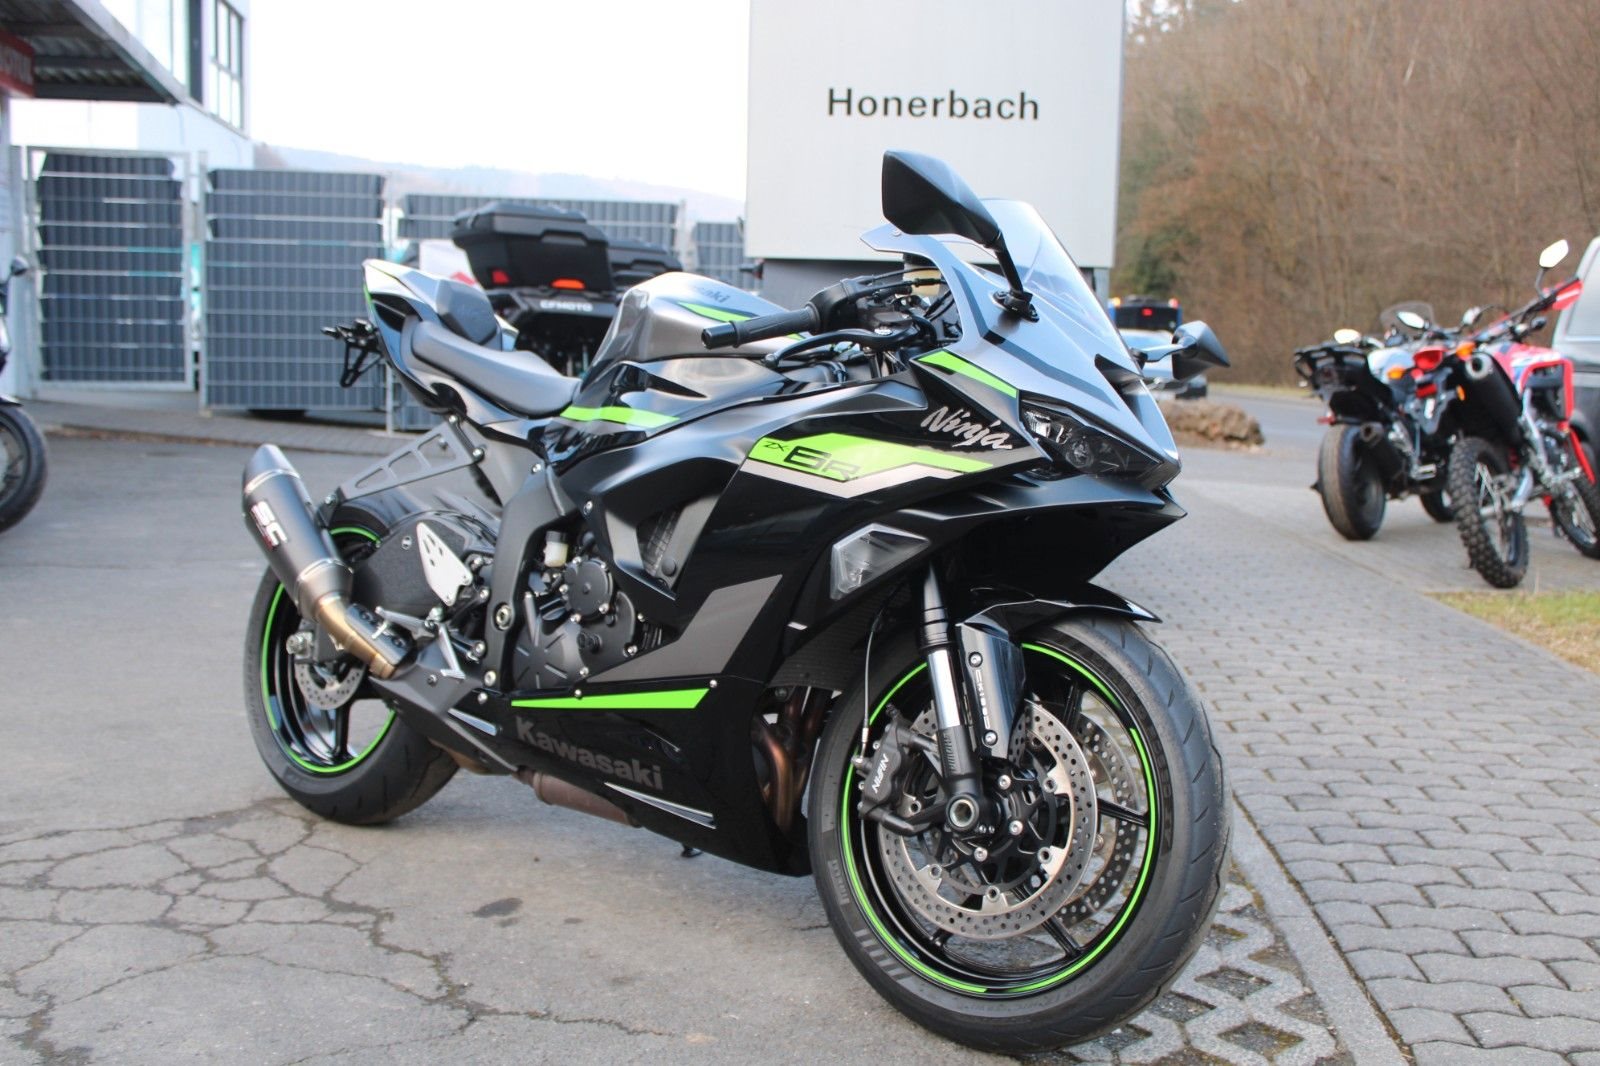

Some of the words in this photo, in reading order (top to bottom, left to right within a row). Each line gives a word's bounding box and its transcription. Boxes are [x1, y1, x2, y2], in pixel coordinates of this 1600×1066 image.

[828, 87, 1039, 120] Honerbach
[763, 441, 788, 452] ZX
[920, 405, 1013, 450] Ninja
[515, 715, 664, 791] Kawasaki
